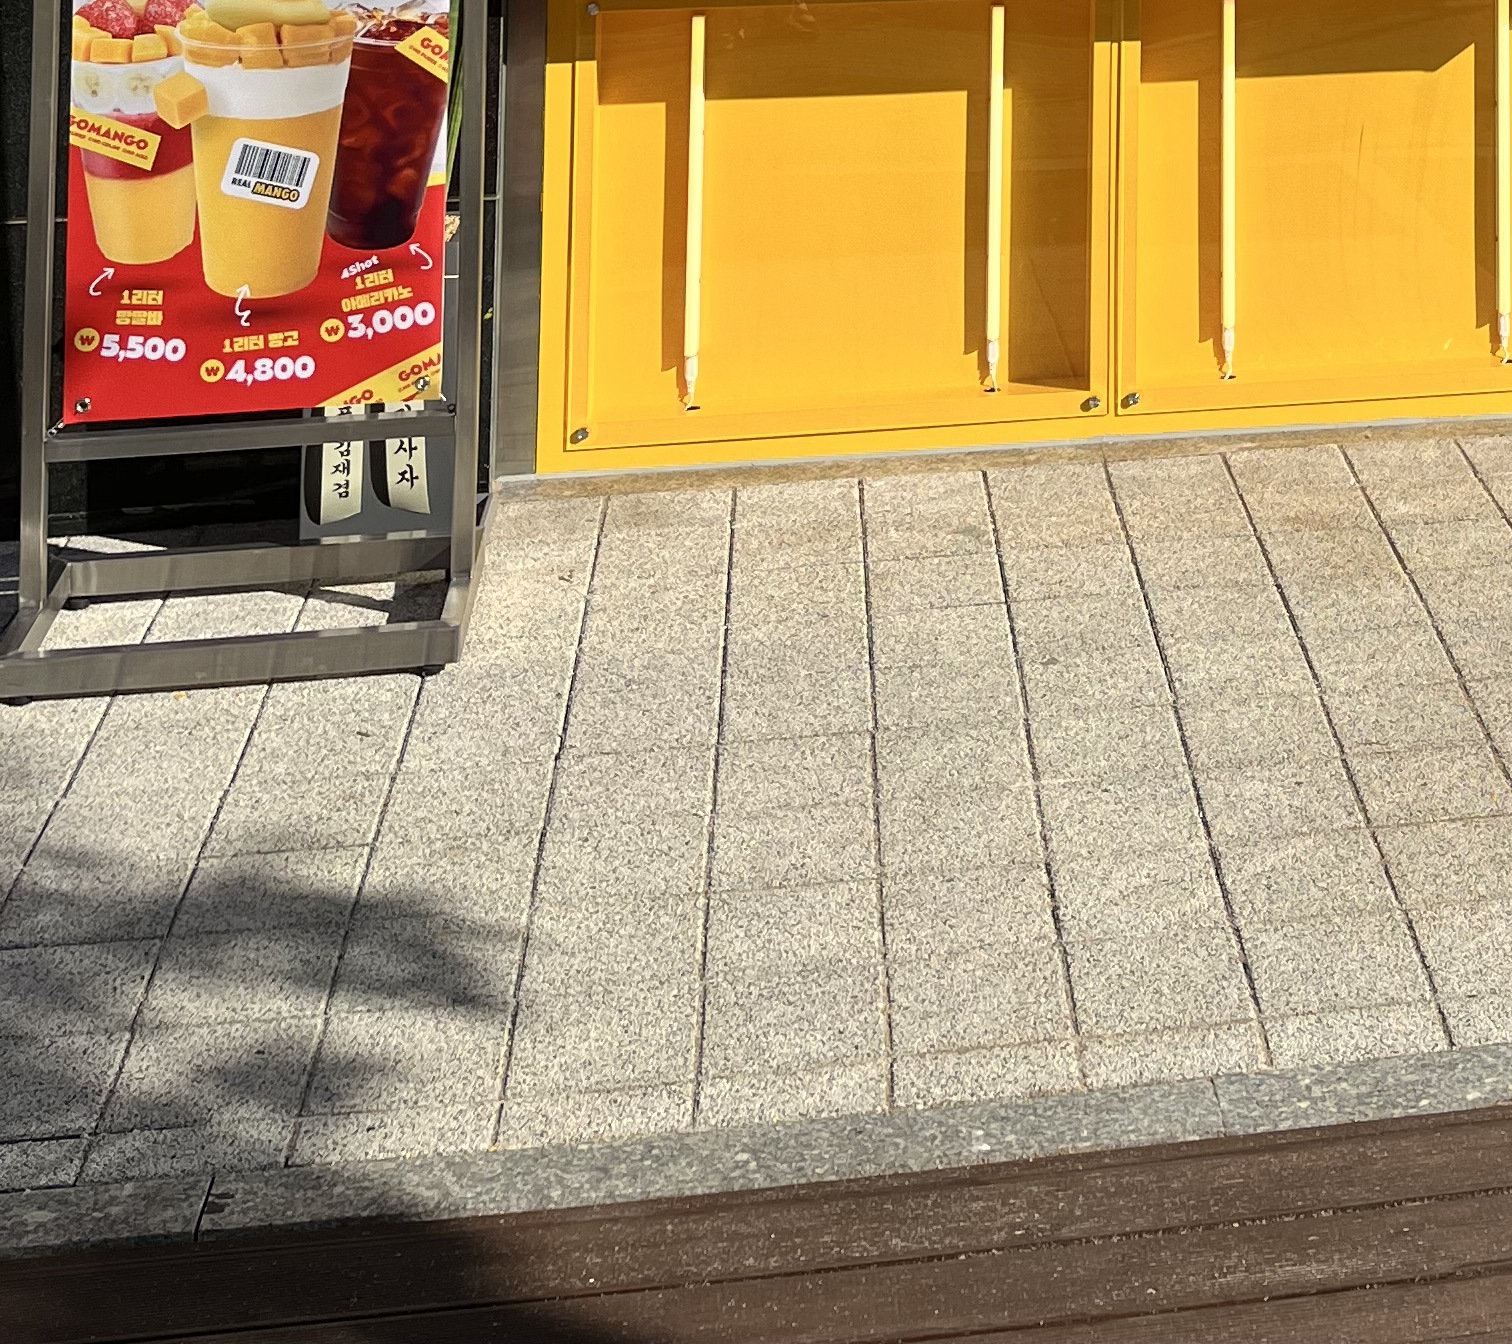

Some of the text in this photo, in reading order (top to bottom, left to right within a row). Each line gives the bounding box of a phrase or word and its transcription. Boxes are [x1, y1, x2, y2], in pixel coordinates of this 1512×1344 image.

[252, 181, 301, 202] MANGO
[340, 255, 380, 281] 4Shot
[354, 268, 395, 291] 1리터
[120, 289, 164, 306] 1리터
[341, 285, 414, 313] 아메리카노
[222, 330, 300, 354] 1리터 망고
